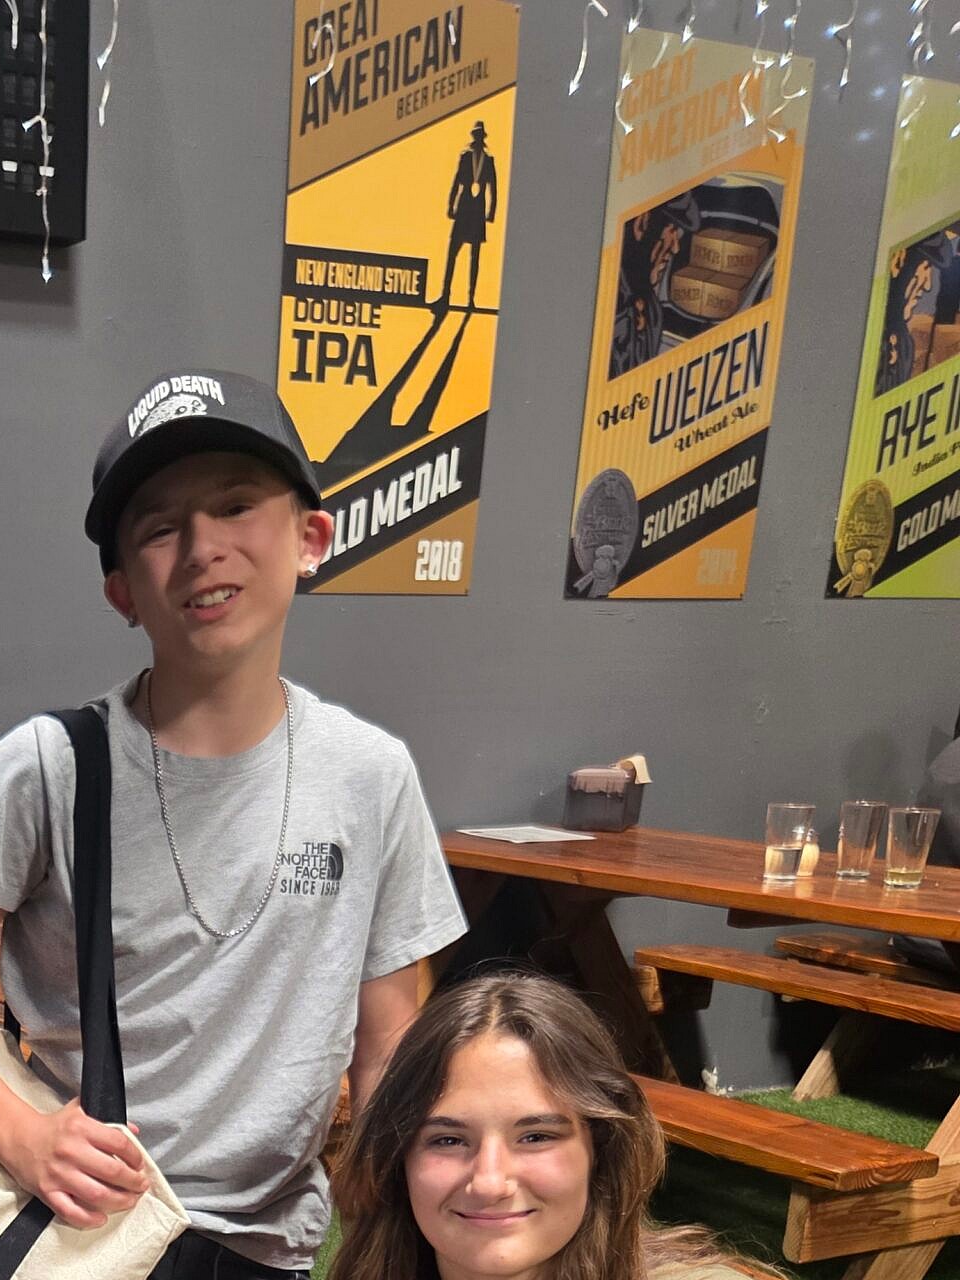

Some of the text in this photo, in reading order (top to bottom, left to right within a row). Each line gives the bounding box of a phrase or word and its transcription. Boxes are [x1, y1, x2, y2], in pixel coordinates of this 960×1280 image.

[300, 5, 464, 137] AMERICAN
[396, 58, 489, 120] BEER FESTIVAL
[295, 258, 421, 295] NEW ENGLAND STYLE
[293, 297, 382, 329] DOUBLE
[289, 329, 378, 387] IPA
[597, 321, 769, 444] Hefe WEIZEN
[127, 375, 226, 438] LIQUID DEATH
[674, 402, 760, 452] Wheat Ale
[370, 445, 462, 536] MEDAL
[641, 488, 700, 548] SILVER
[699, 456, 757, 515] MEDAL
[896, 500, 942, 553] GOLD
[414, 539, 464, 582] 2018
[280, 853, 328, 867] NORTH
[295, 866, 326, 880] FACE
[302, 842, 329, 855] THE
[280, 879, 316, 896] SINCE
